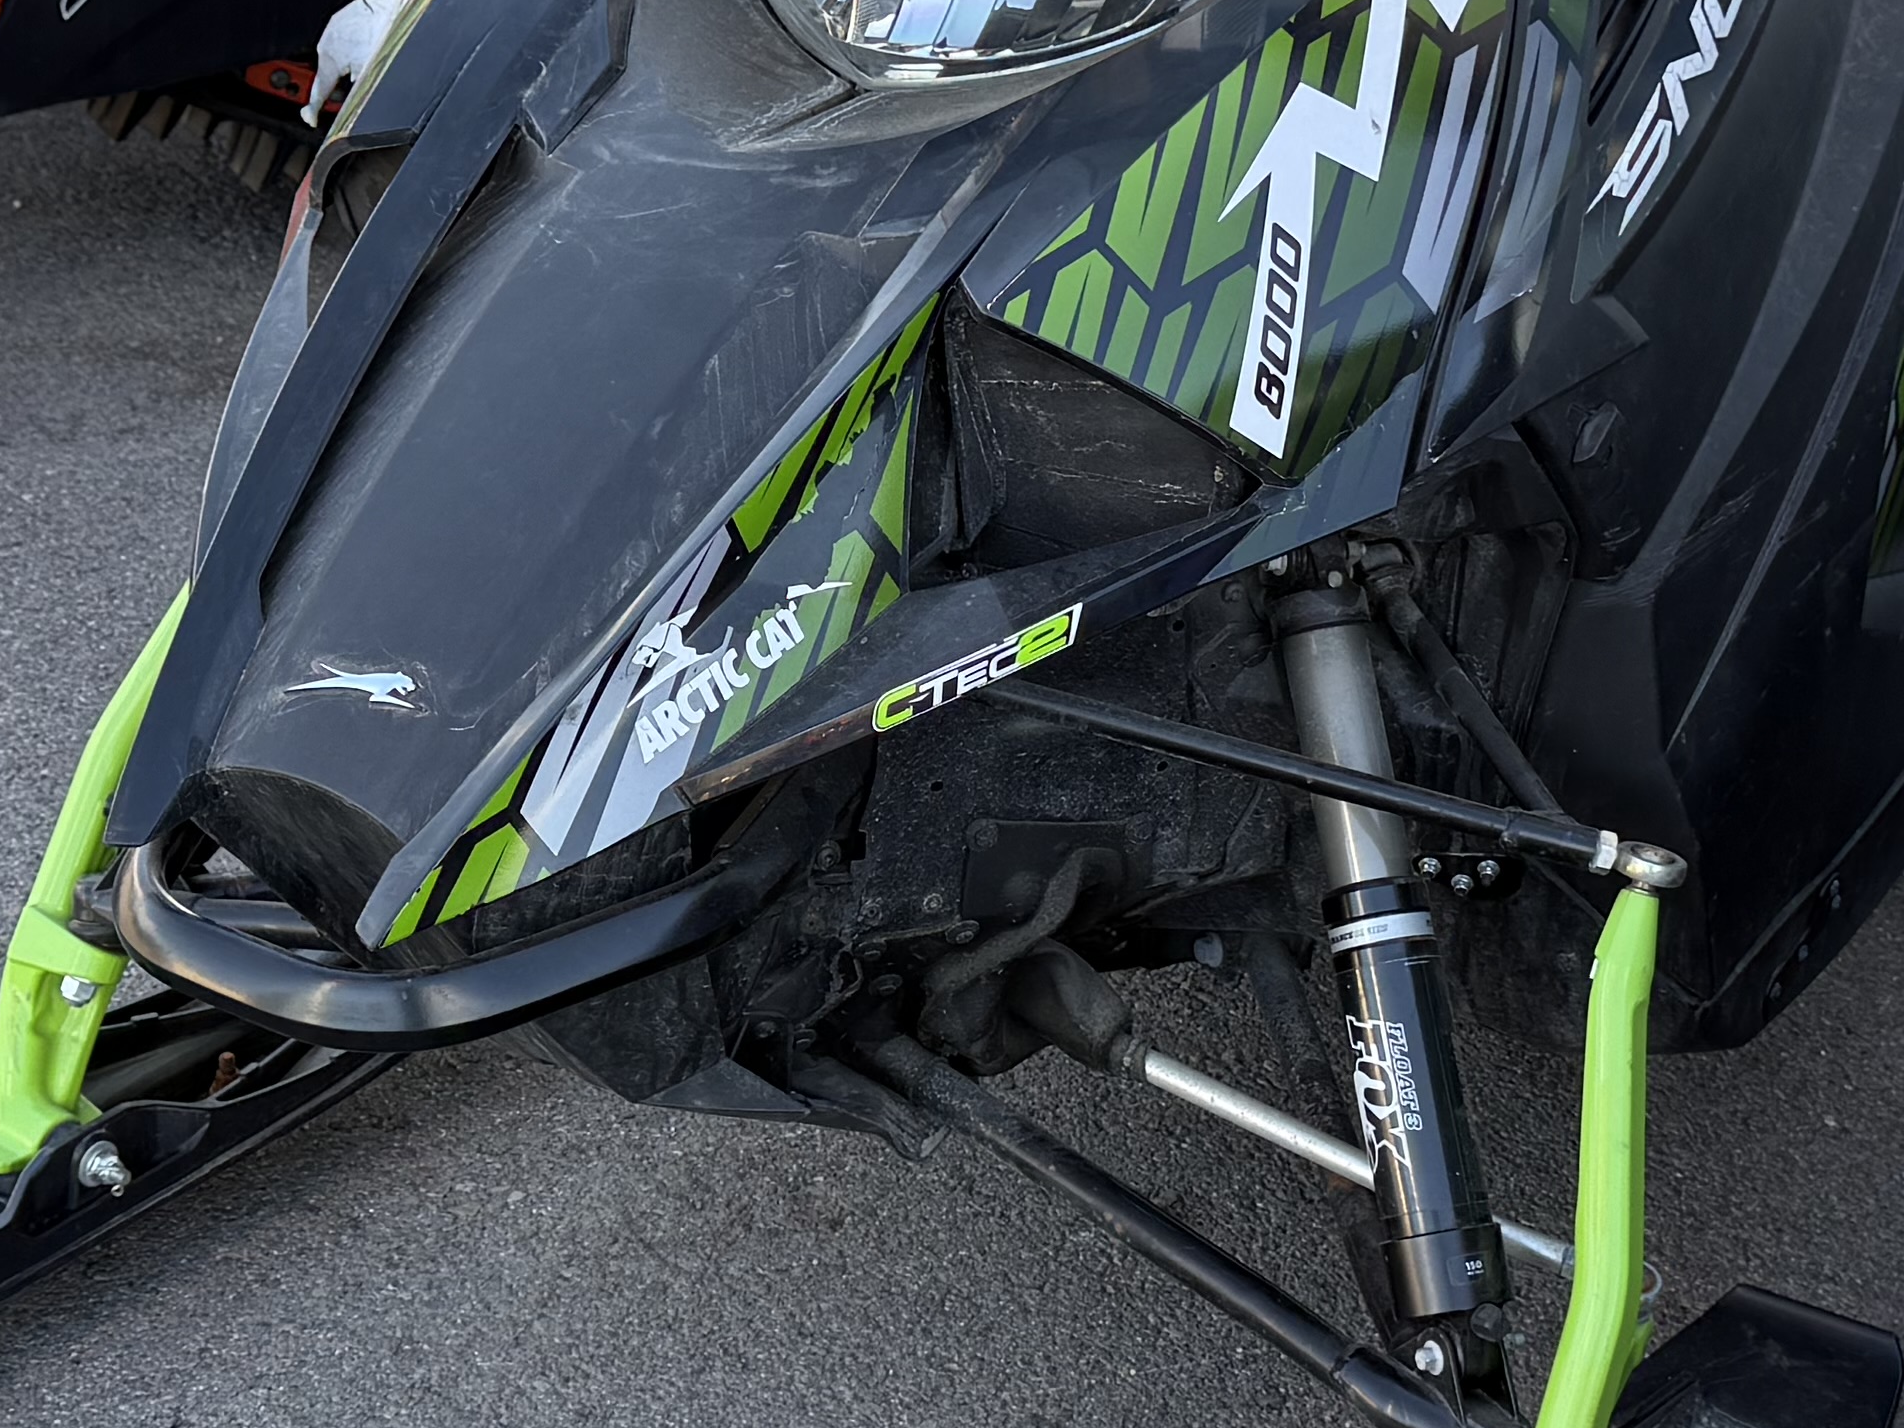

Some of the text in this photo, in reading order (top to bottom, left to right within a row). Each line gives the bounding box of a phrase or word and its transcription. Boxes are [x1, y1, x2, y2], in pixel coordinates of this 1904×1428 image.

[1254, 222, 1302, 421] 8000
[635, 600, 805, 764] ARCTIC CAT
[1346, 1014, 1412, 1174] FOX
[1386, 1021, 1421, 1112] FLOAT
